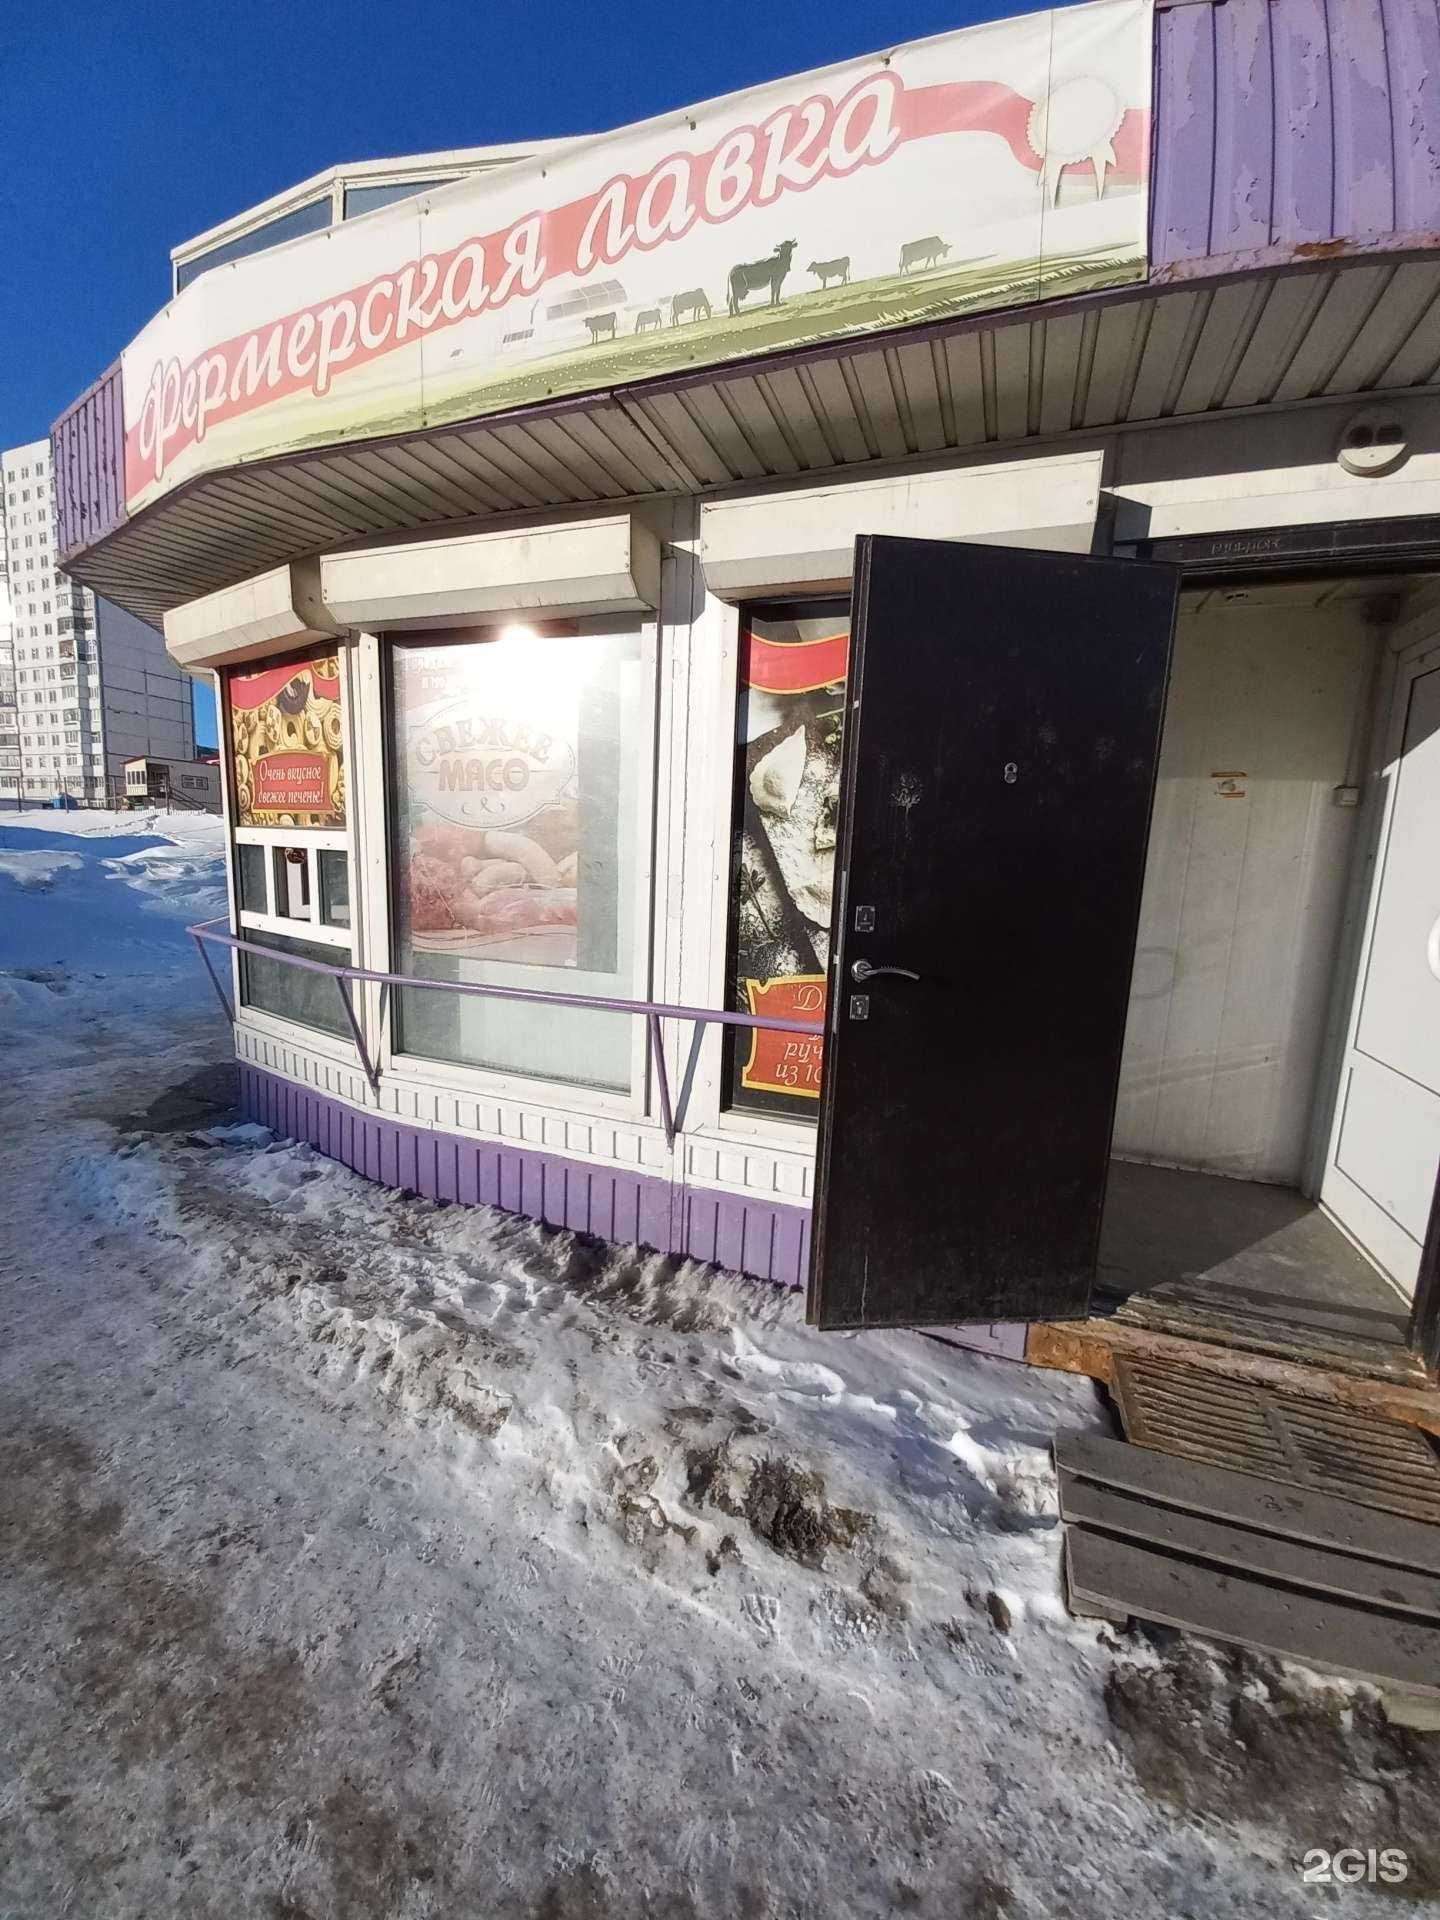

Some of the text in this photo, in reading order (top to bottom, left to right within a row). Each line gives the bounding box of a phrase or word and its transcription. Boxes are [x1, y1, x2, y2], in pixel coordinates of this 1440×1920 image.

[138, 75, 902, 478] Фермерская лавка
[260, 760, 322, 785] Очень вкусное
[288, 781, 325, 804] печенье!
[775, 1062, 799, 1086] из
